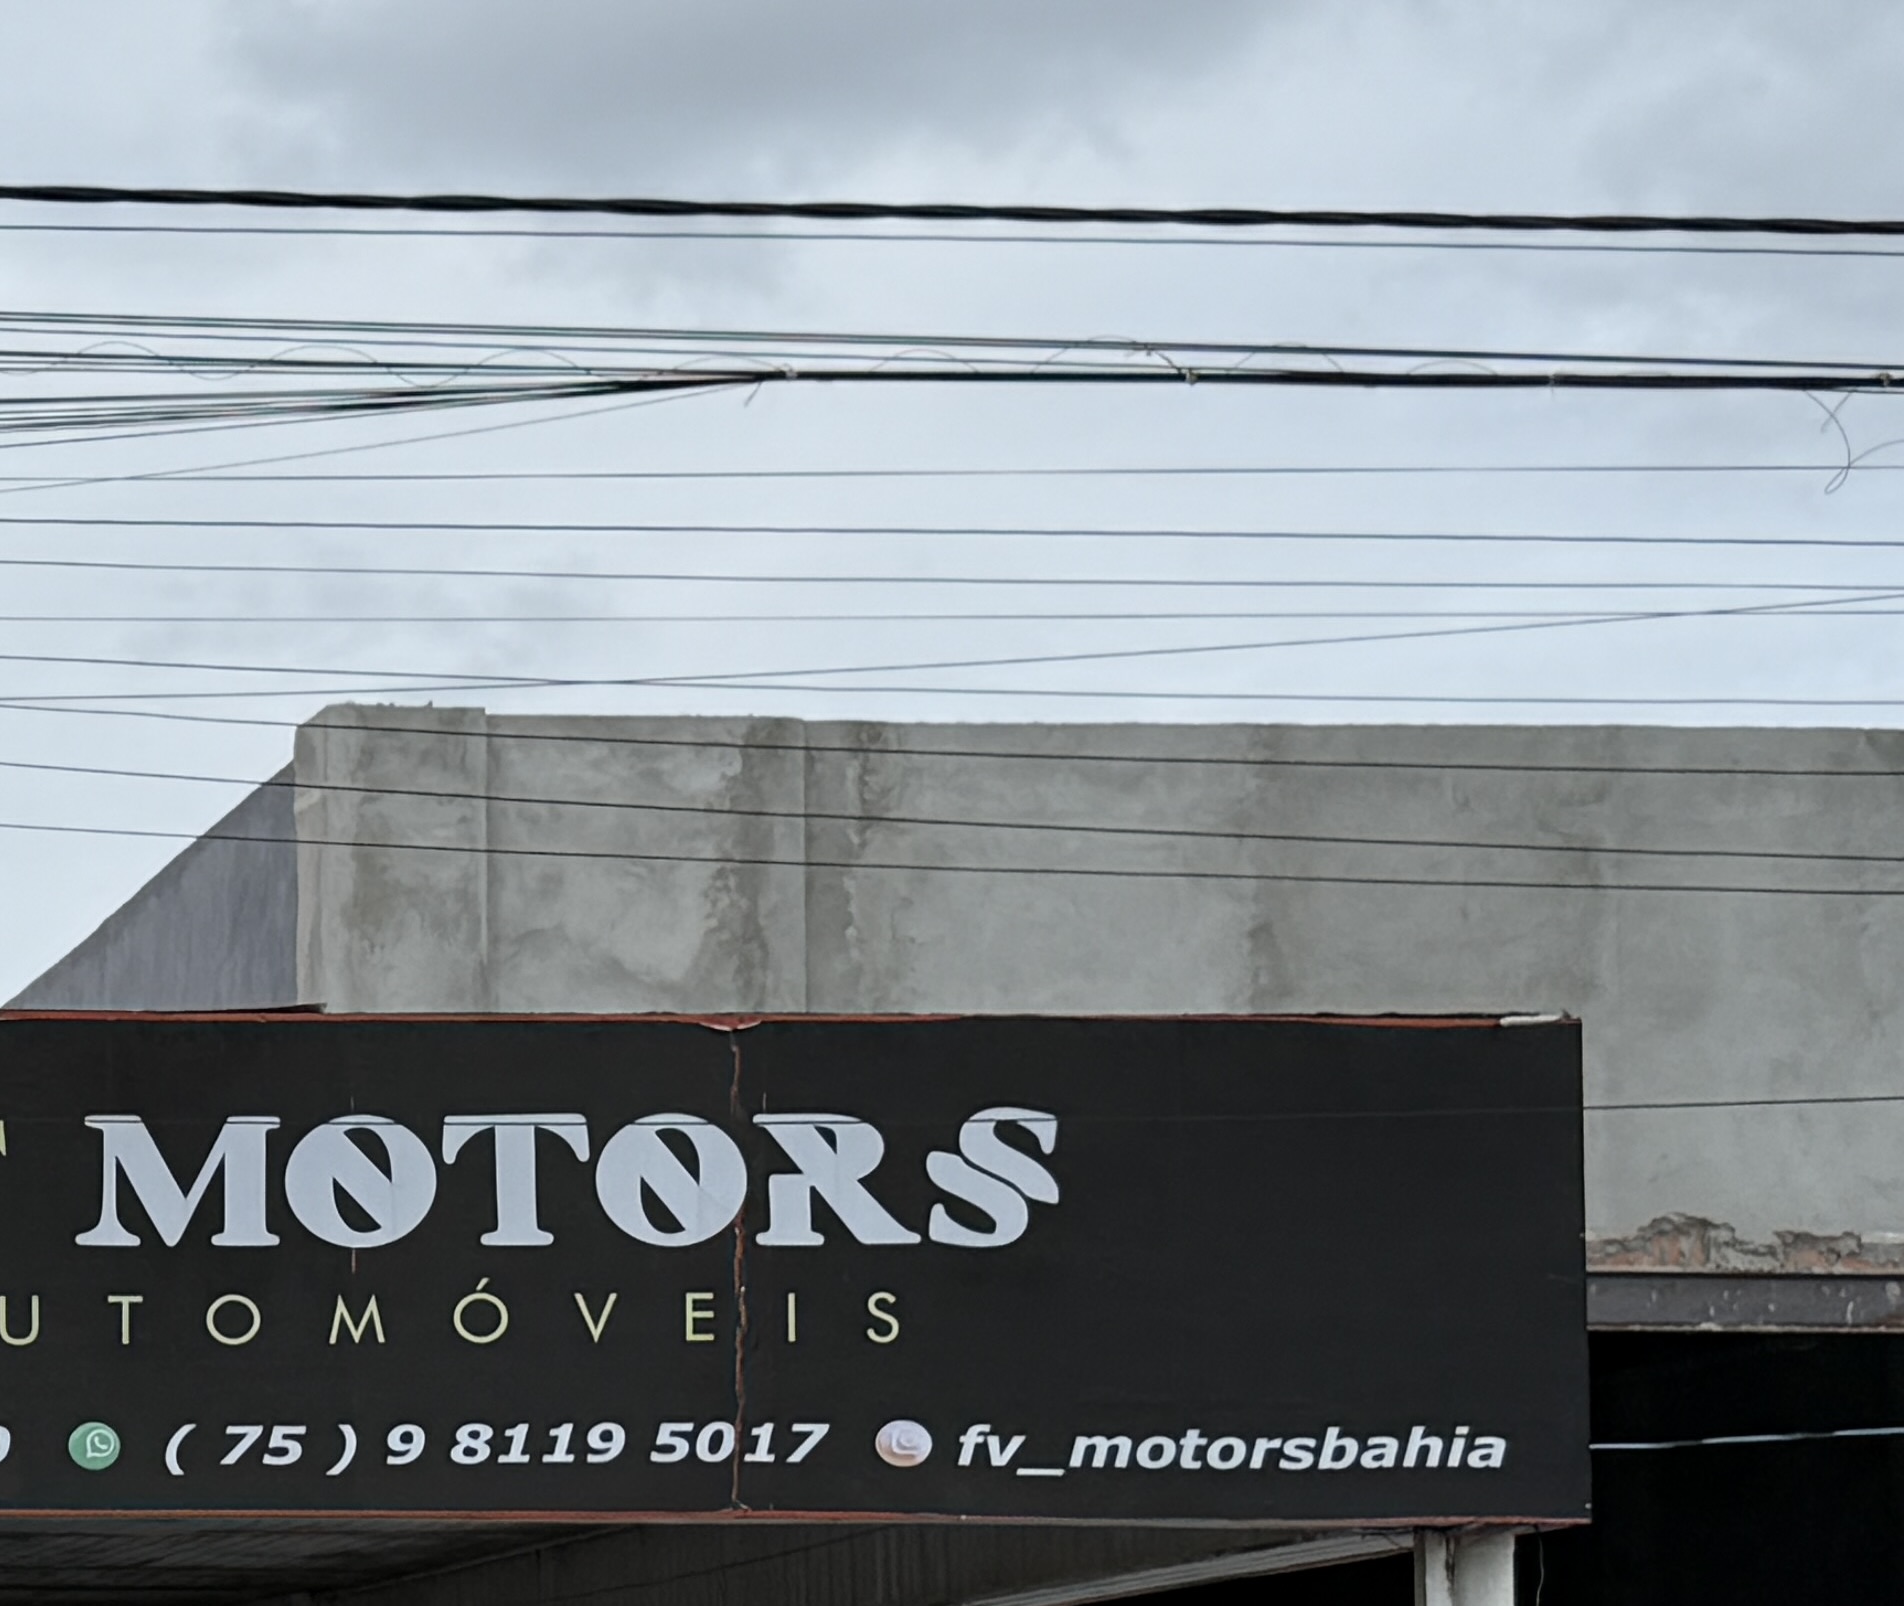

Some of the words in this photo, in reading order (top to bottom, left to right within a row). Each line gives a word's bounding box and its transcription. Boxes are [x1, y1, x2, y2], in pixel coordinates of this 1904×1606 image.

[74, 1106, 1061, 1249] MOTORS
[386, 1423, 426, 1465] 9
[450, 1422, 626, 1465] 8119
[650, 1421, 830, 1463] 5017
[957, 1423, 1507, 1477] fv_motorsbahia
